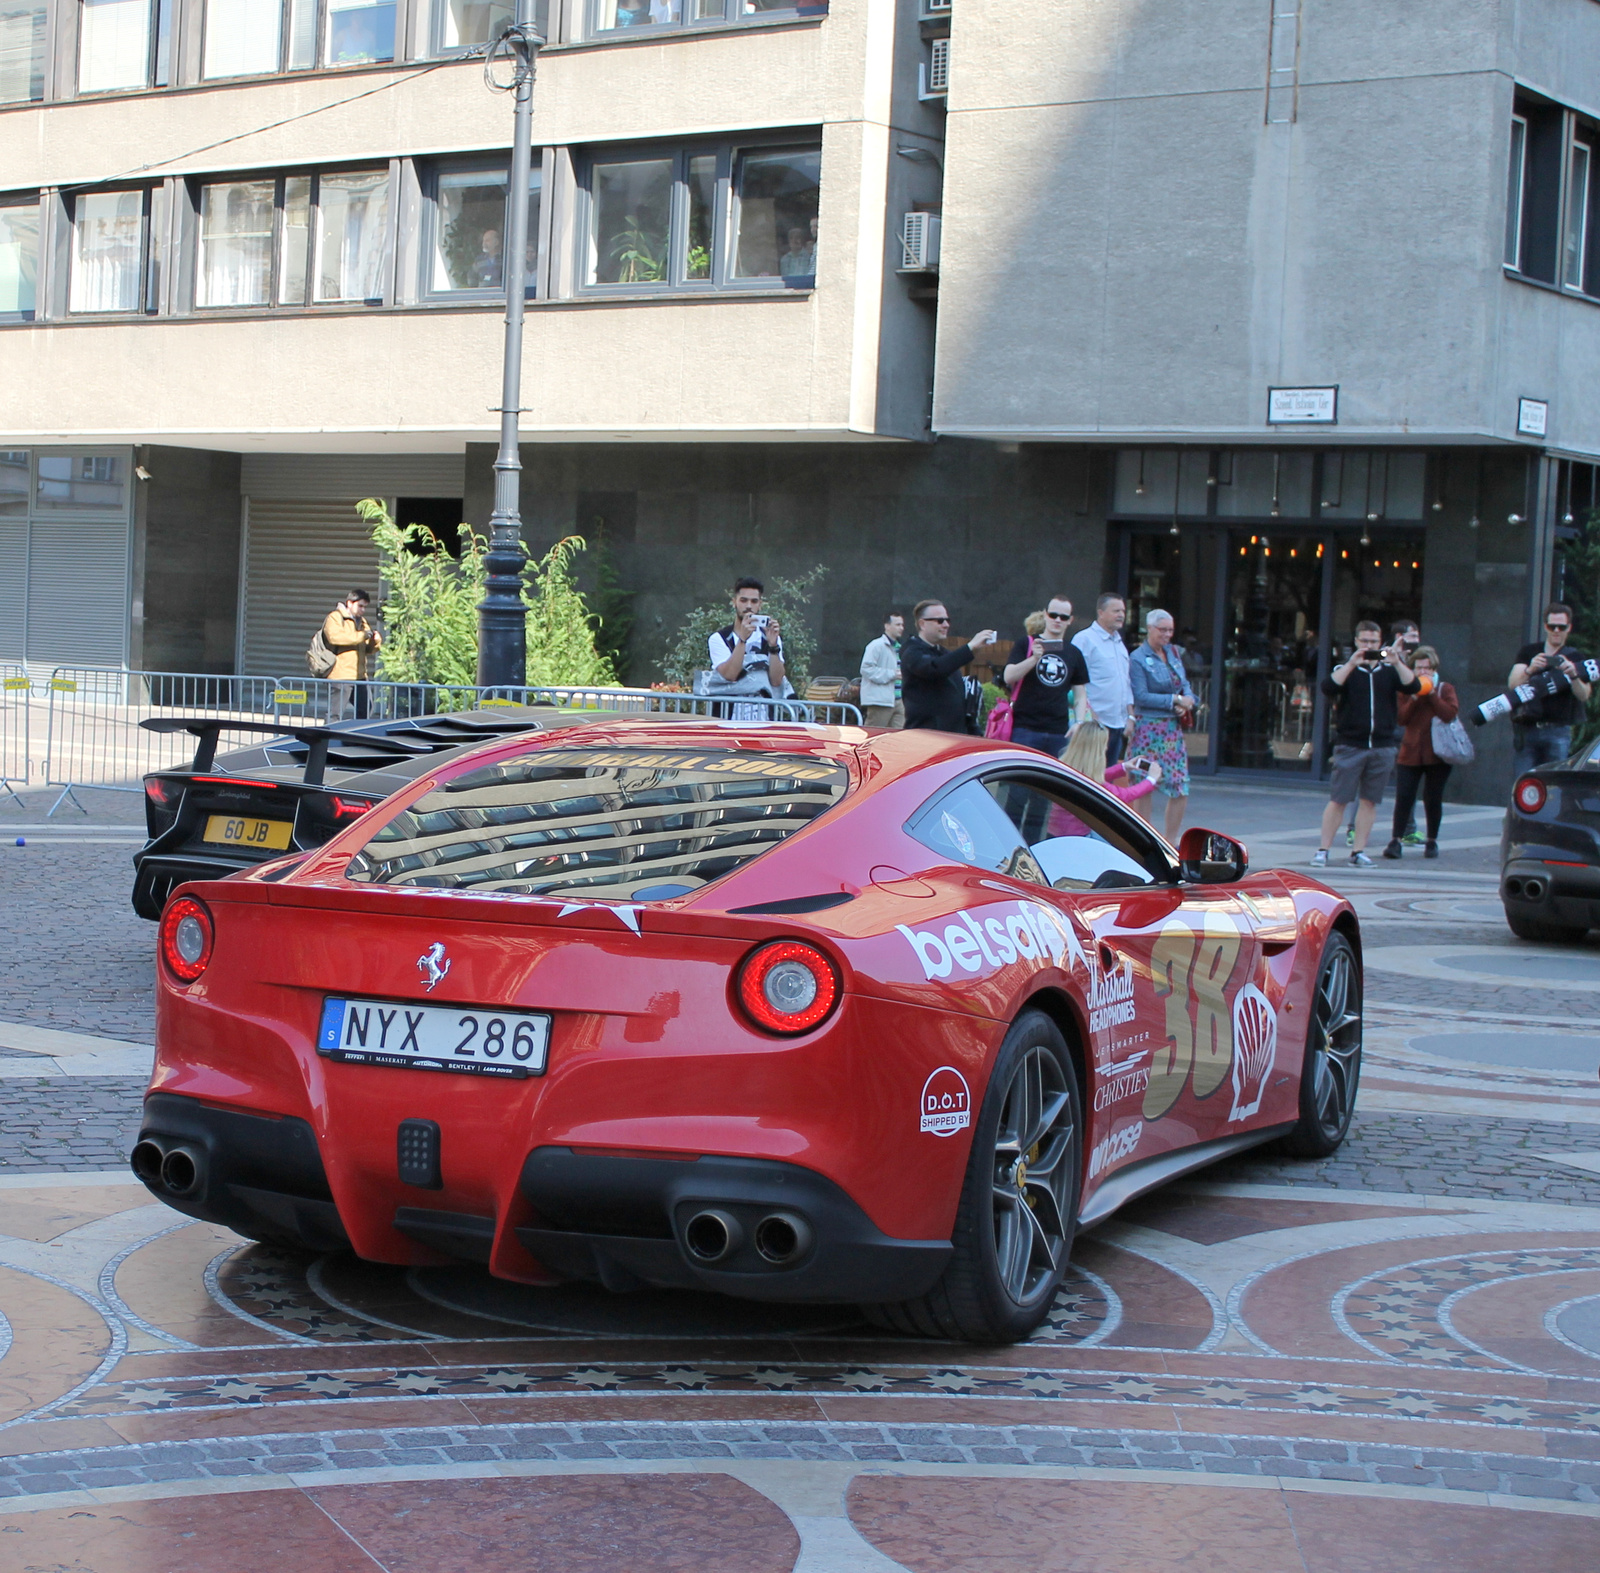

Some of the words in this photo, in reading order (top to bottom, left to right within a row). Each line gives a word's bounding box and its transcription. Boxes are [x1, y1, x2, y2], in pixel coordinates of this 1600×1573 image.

[276, 692, 304, 701] profirent
[497, 752, 706, 770] GUMBALL
[706, 757, 838, 780] 3000
[224, 820, 246, 840] 60
[246, 822, 270, 842] JB
[894, 900, 1064, 980] betsafe
[1086, 955, 1135, 1010] Marshall
[1089, 1000, 1136, 1034] HEADPHONES
[1142, 908, 1241, 1122] 38
[327, 1030, 336, 1041] S
[346, 1006, 425, 1052] NYX
[454, 1015, 536, 1061] 286
[1095, 1031, 1150, 1058] JETSMARTER
[344, 1053, 365, 1061] Ferrari
[375, 1056, 407, 1065] MASERATI
[448, 1063, 475, 1071] BENTLEY
[1093, 1067, 1150, 1112] CHRISTIE'S
[922, 1116, 957, 1128] SHIPPED
[958, 1115, 969, 1124] BY
